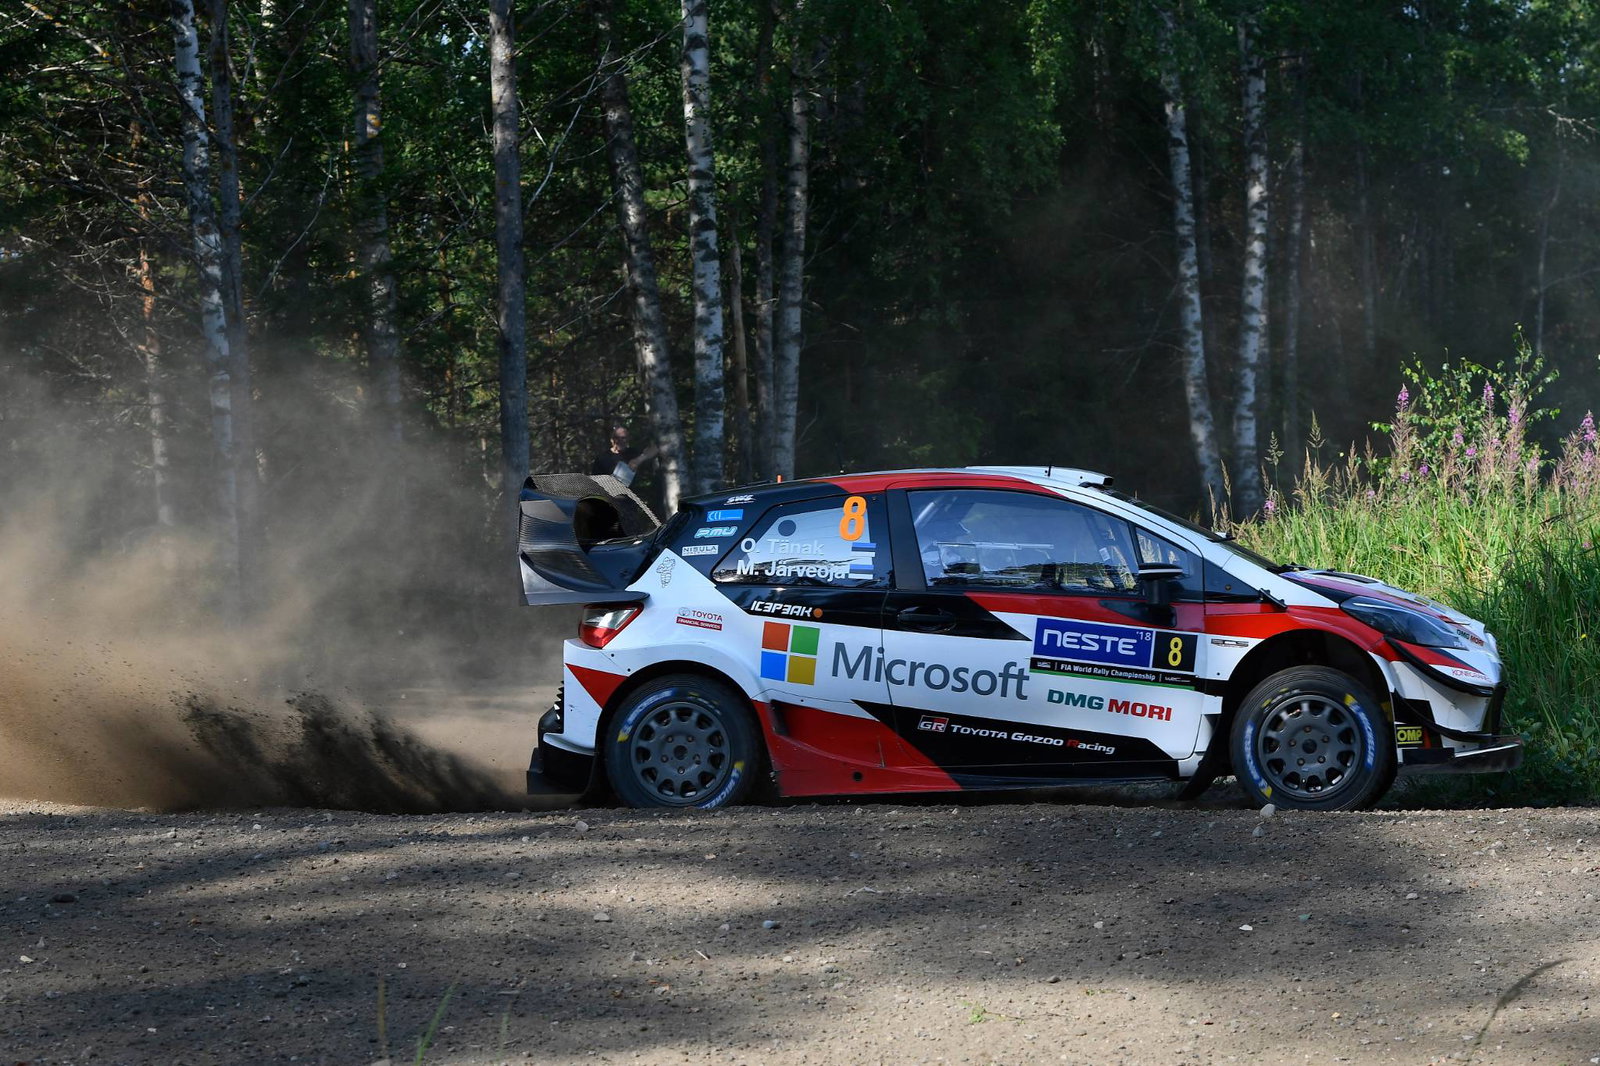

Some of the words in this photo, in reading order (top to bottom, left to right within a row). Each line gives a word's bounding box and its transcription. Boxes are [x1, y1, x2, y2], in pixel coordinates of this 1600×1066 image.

[839, 496, 867, 541] 8
[683, 545, 718, 553] NISULA
[767, 538, 824, 556] Tänak
[737, 560, 759, 576] M.
[765, 560, 848, 582] Järveoja
[692, 610, 722, 622] TOYOTA
[1042, 629, 1138, 656] NESTE
[1168, 637, 1182, 667] 8
[832, 642, 1030, 700] Microsoft
[1073, 665, 1092, 673] World
[1093, 667, 1110, 677] Rally
[1110, 669, 1156, 681] Championship
[1047, 689, 1104, 710] DMG
[1107, 698, 1172, 721] MORI
[919, 720, 946, 732] GR
[950, 724, 1008, 739] TOYOTA
[1011, 732, 1063, 746] GAZOO
[1067, 739, 1115, 755] Racing
[1396, 729, 1423, 741] OMP
